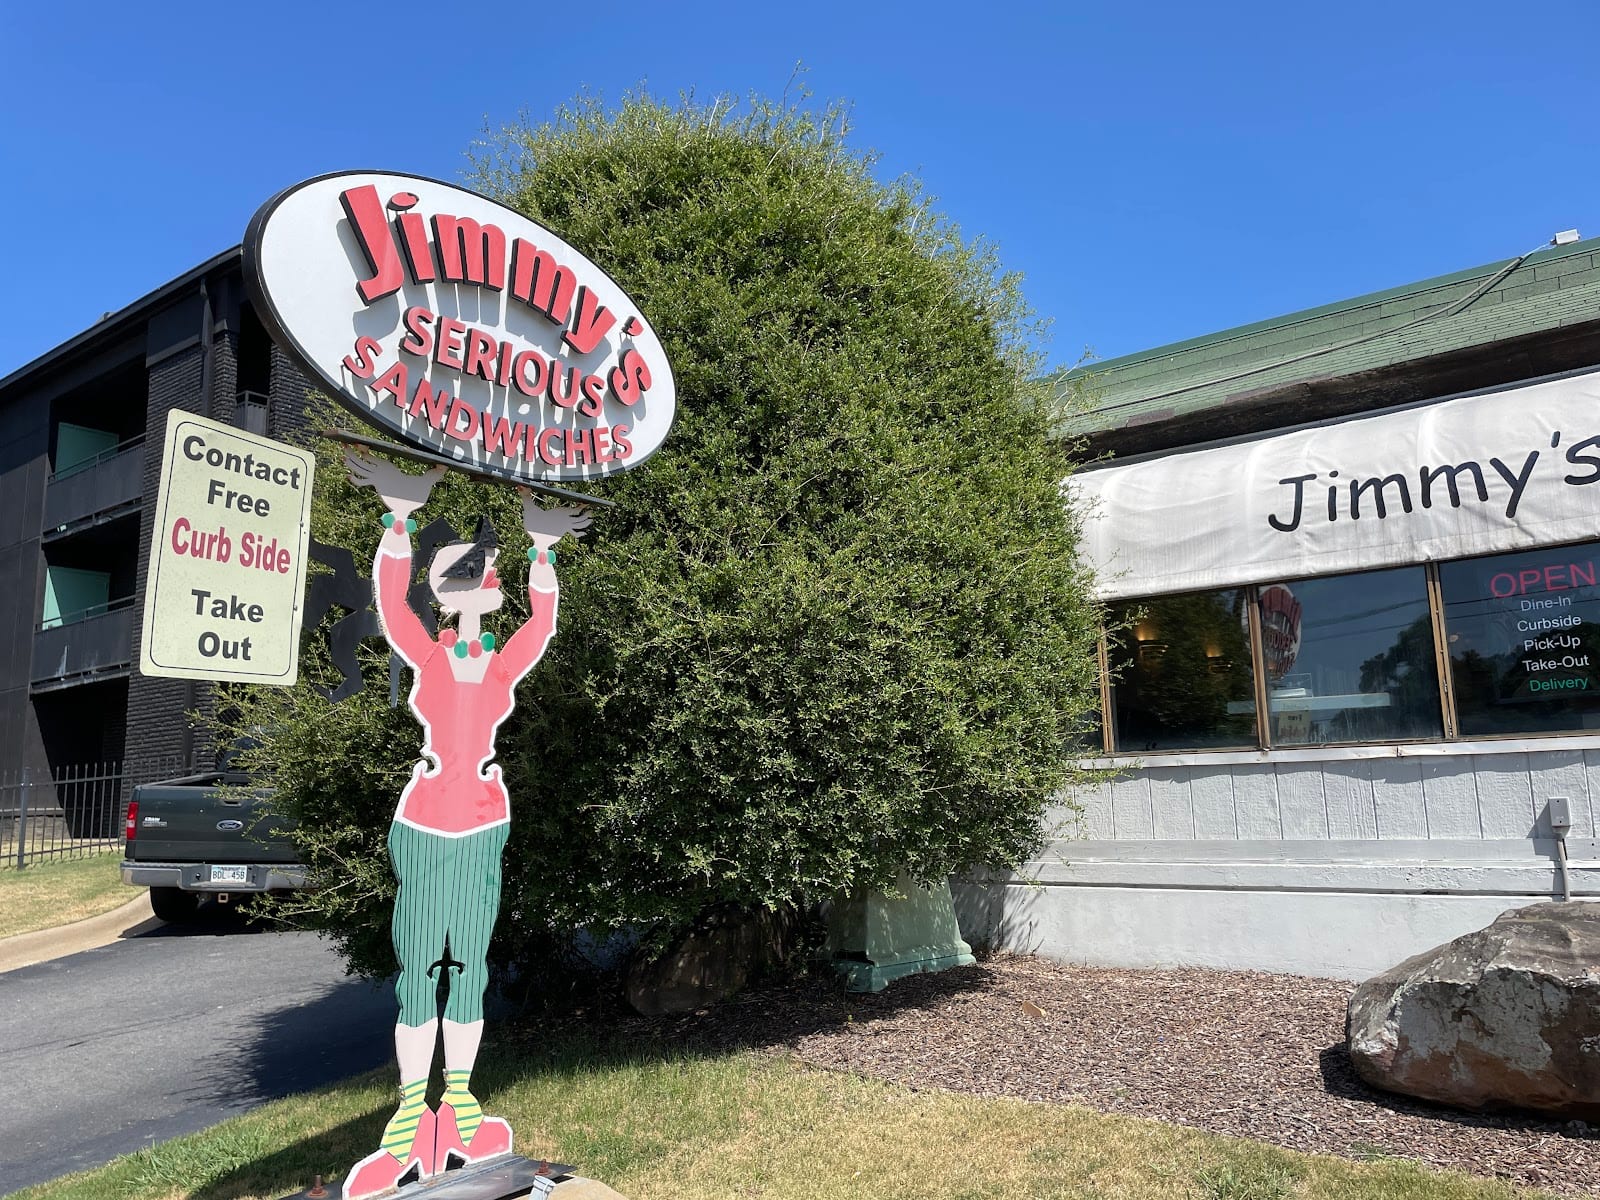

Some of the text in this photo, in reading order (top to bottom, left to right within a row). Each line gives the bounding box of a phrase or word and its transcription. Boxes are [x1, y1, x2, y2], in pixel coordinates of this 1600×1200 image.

[340, 184, 652, 407] Jimmy's
[401, 306, 605, 418] SERIOUS
[343, 336, 633, 466] SANDWICHES
[183, 435, 300, 490] Contact
[207, 479, 270, 517] Free
[1268, 431, 1600, 533] Jimmy's
[172, 517, 291, 574] Curb Side
[1490, 561, 1596, 598] OPEN
[191, 589, 264, 623] Take
[1520, 596, 1571, 612] Dine-In
[1517, 615, 1582, 632] Curbside
[198, 631, 252, 660] Out
[1524, 635, 1581, 652] Pick-Up
[1522, 655, 1590, 672] Take-Out
[1529, 677, 1589, 692] Delivery
